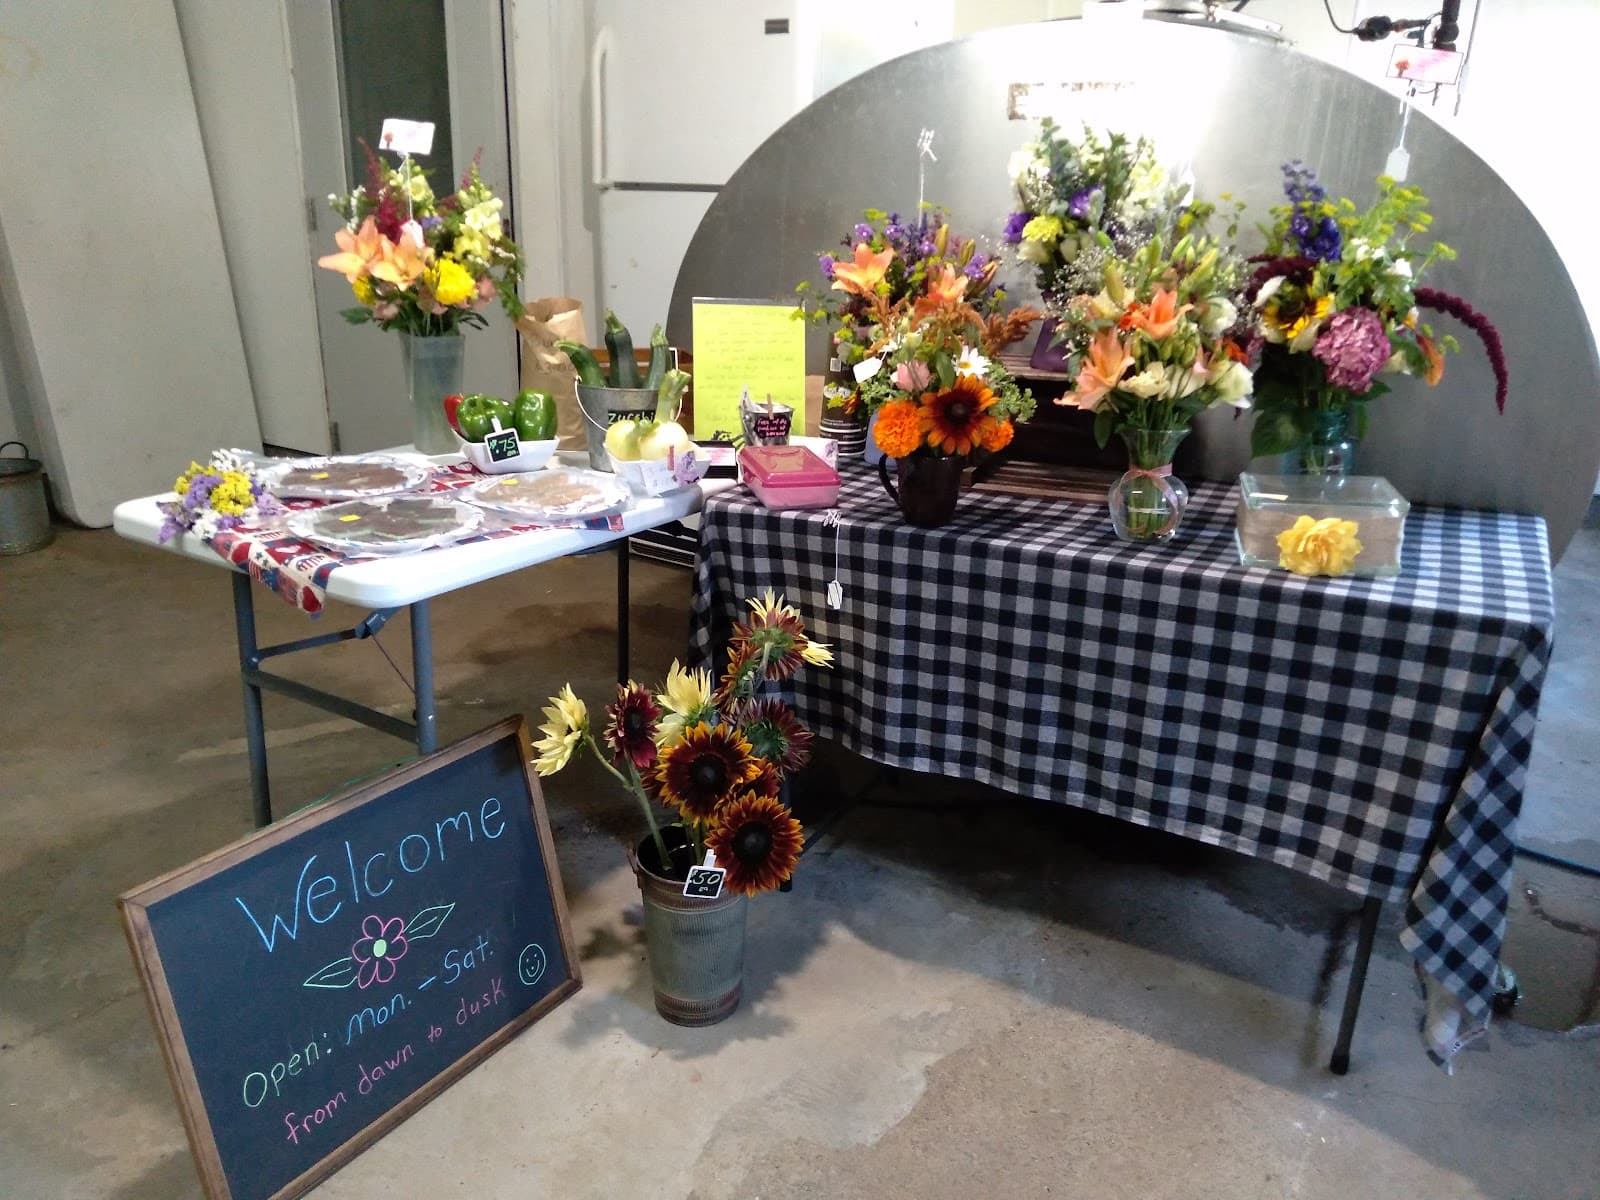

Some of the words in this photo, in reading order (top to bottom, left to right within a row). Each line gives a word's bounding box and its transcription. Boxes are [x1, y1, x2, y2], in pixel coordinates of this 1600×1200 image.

[236, 798, 505, 952] Welcome
[243, 1032, 332, 1108] Open:
[444, 935, 494, 984] Sat.
[284, 1091, 347, 1144] from
[358, 1044, 415, 1095] dawn
[427, 1025, 442, 1042] to
[456, 977, 506, 1025] dusk
